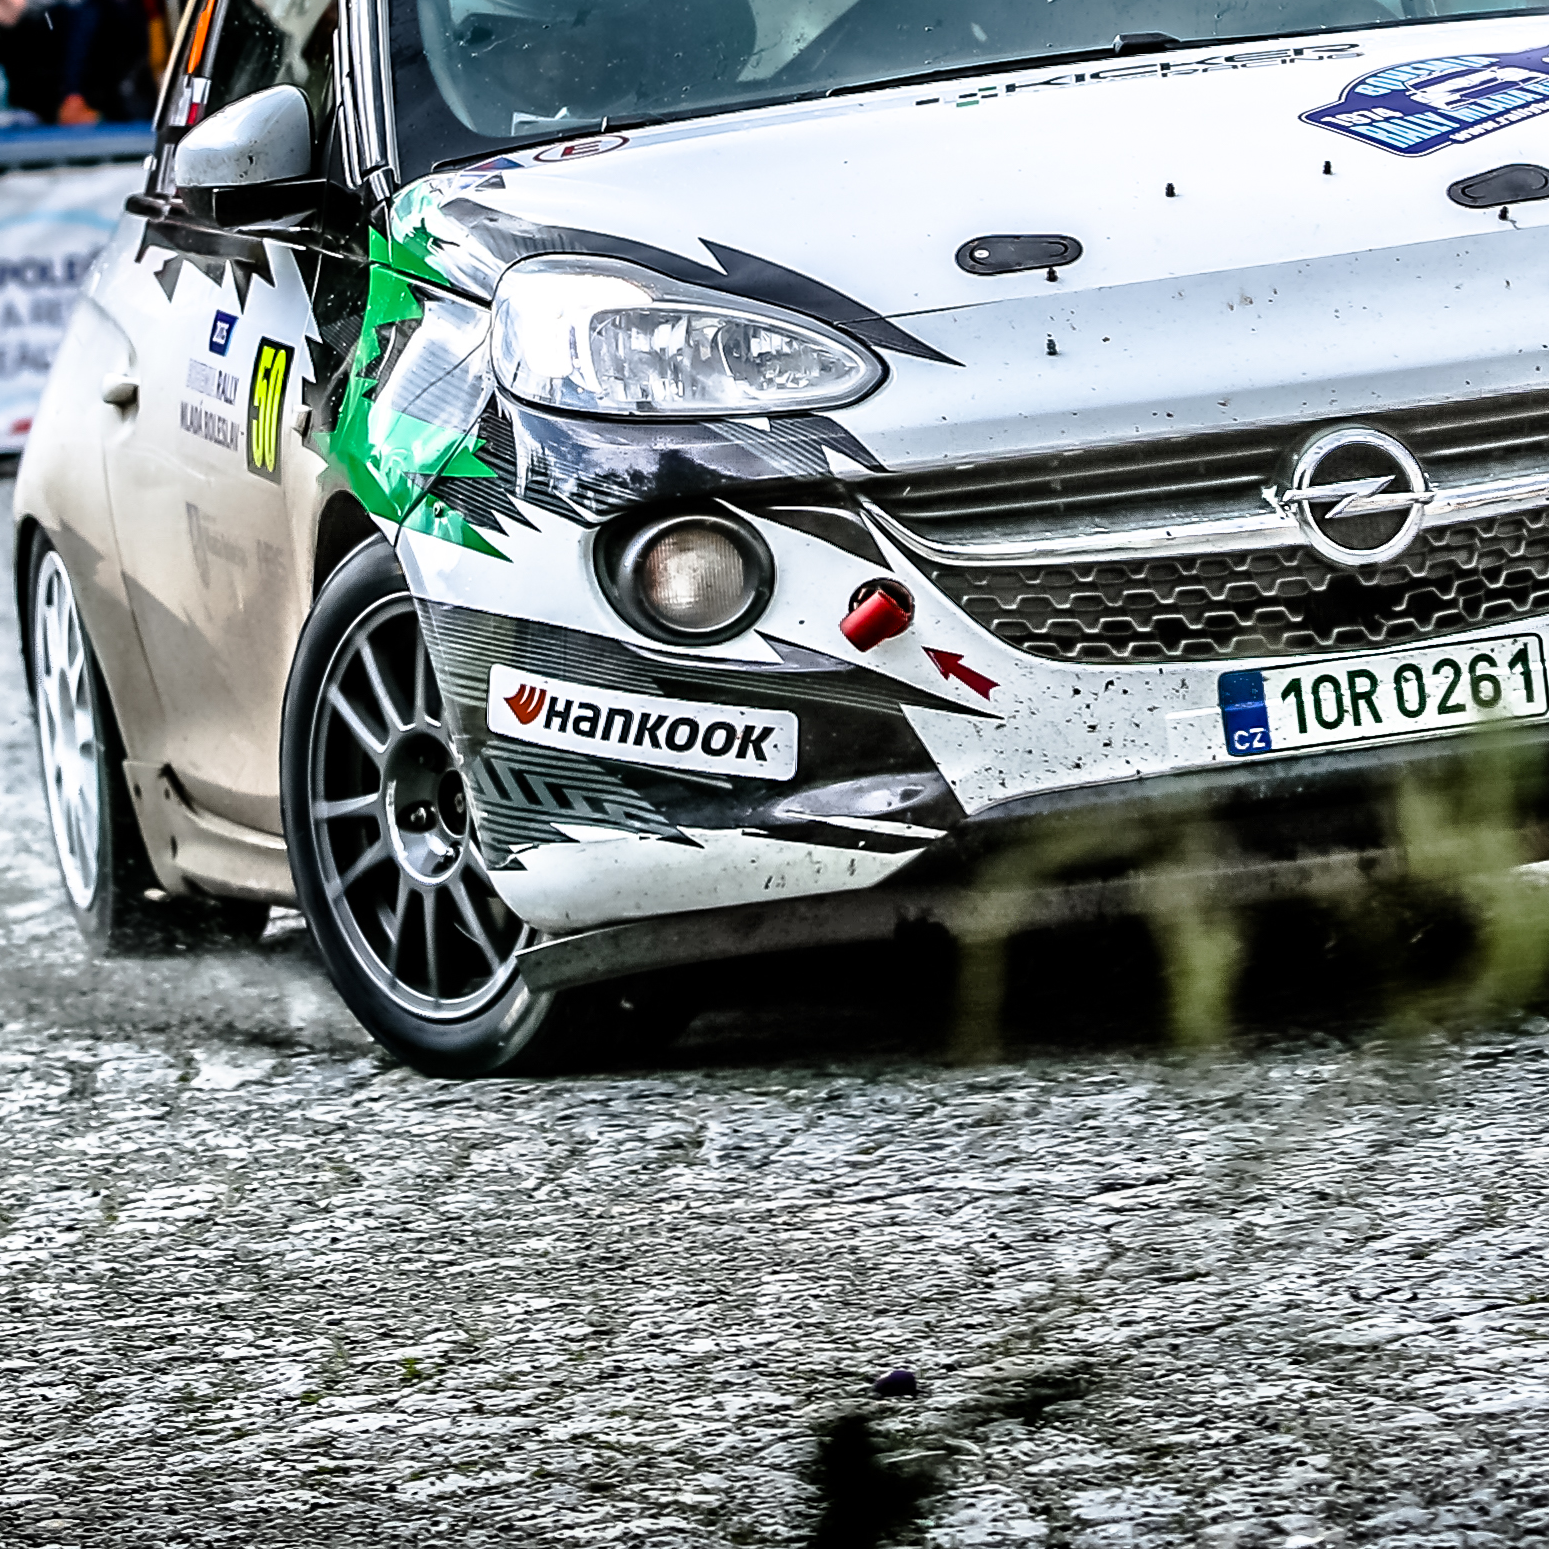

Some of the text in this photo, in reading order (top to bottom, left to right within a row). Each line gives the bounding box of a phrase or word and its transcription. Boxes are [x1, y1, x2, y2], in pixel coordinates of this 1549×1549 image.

[1004, 43, 1360, 95] KICKER
[1320, 106, 1404, 128] 1974
[1349, 110, 1462, 150] RALLY
[253, 345, 287, 473] 50
[1280, 641, 1535, 734] 10R 0261
[1233, 727, 1268, 750] CZ
